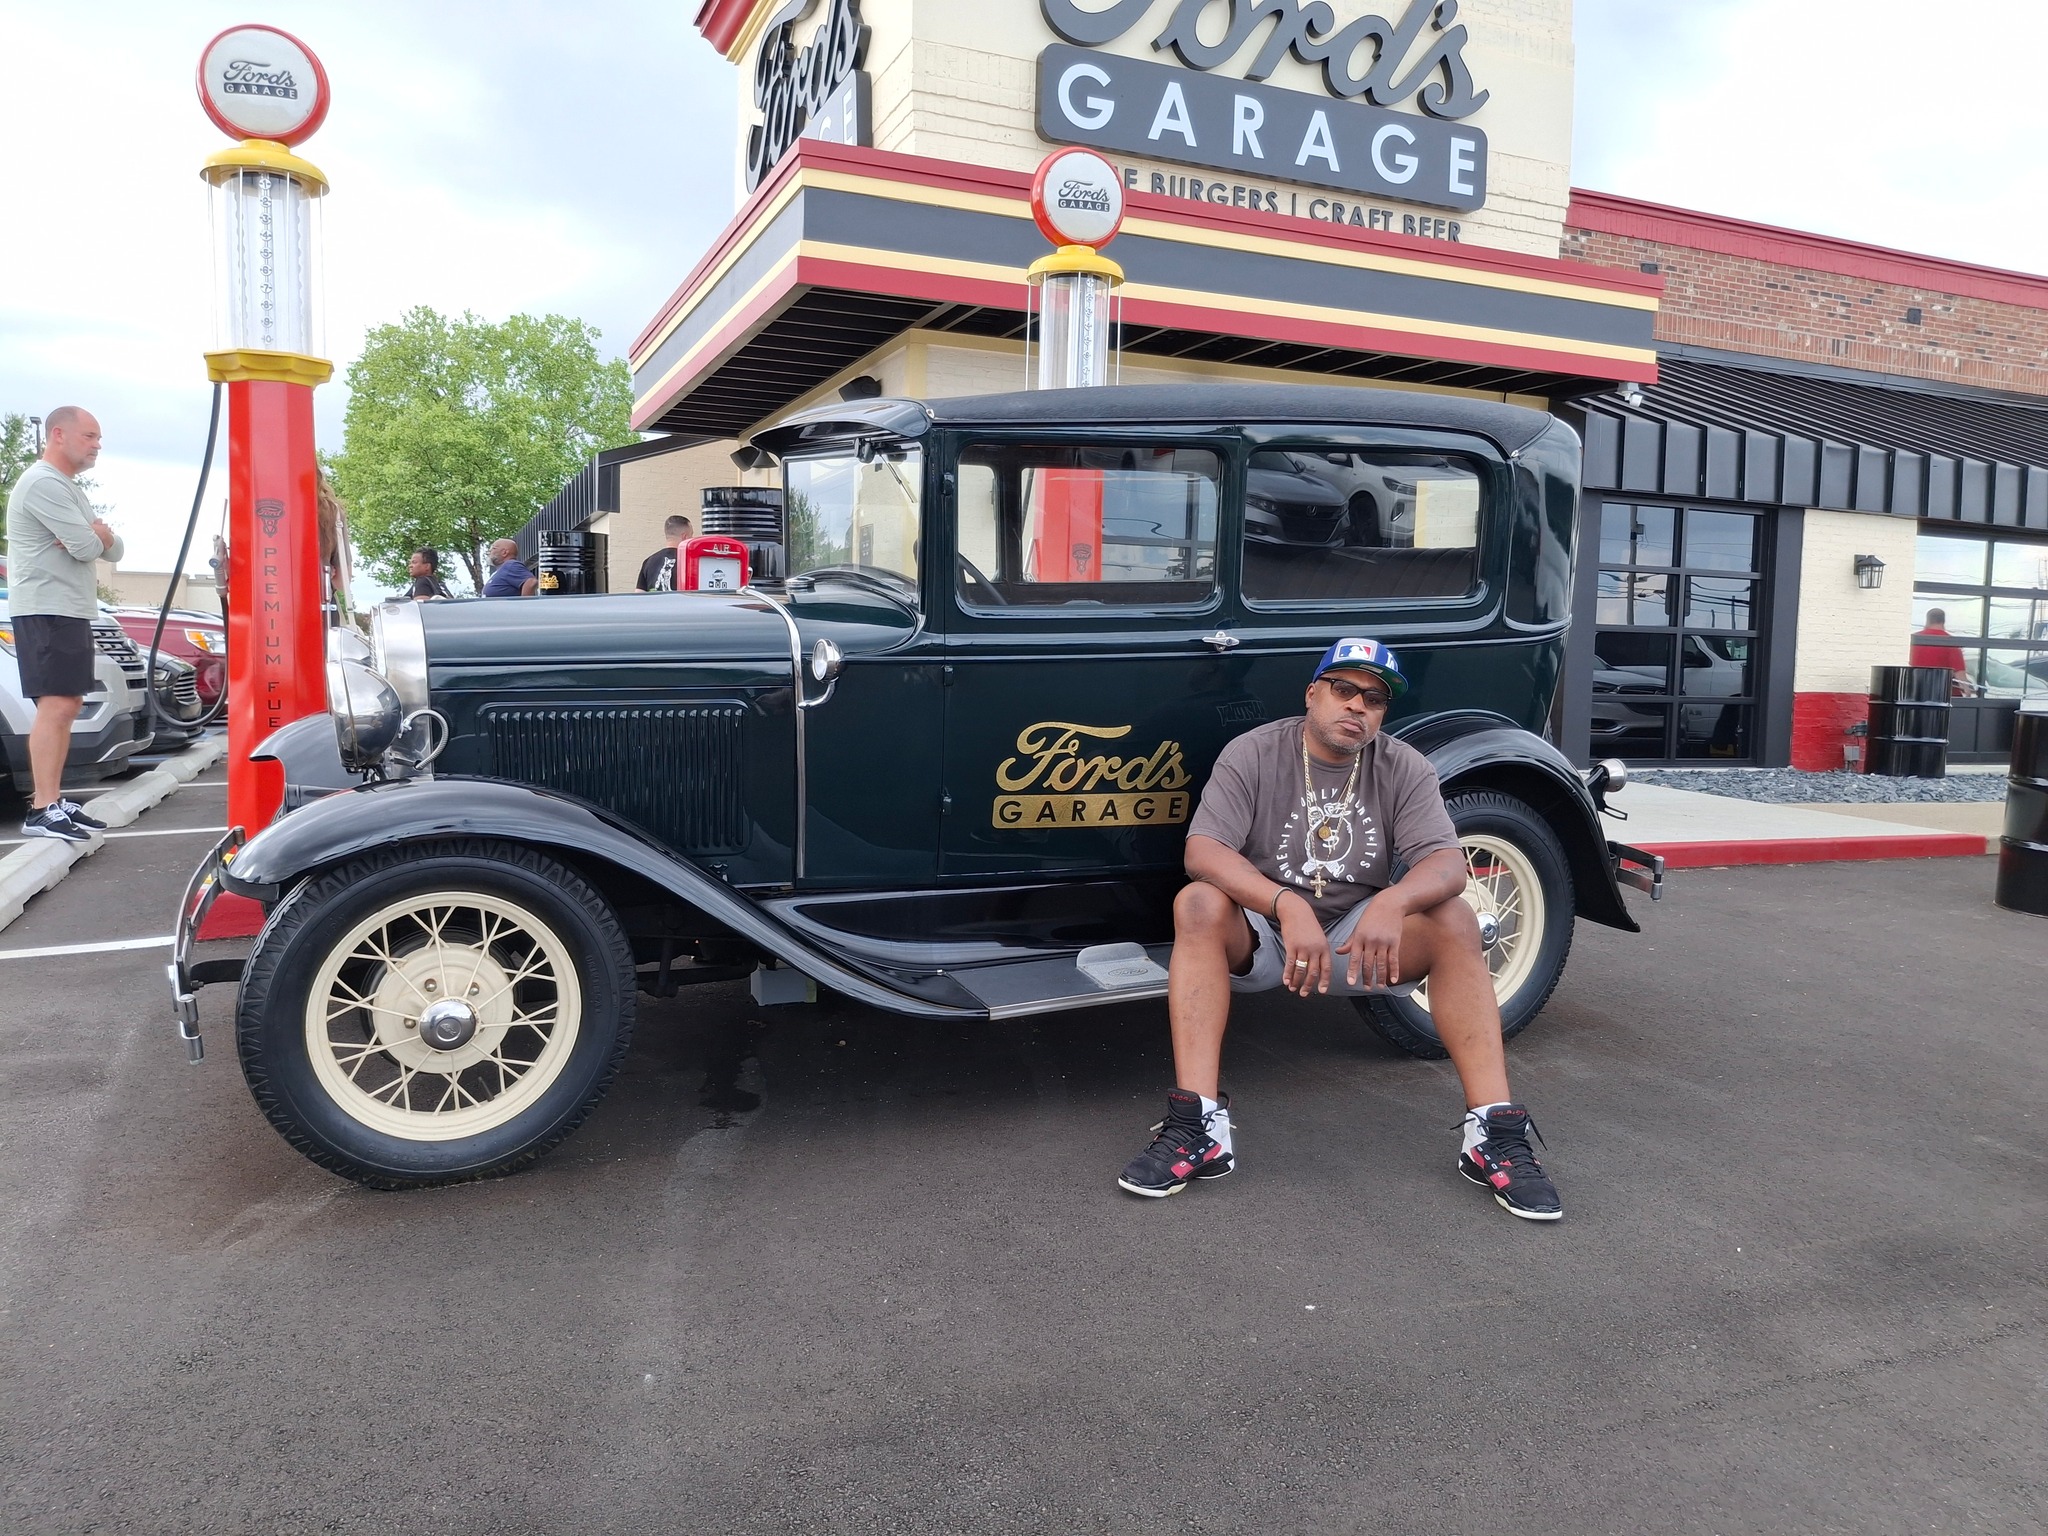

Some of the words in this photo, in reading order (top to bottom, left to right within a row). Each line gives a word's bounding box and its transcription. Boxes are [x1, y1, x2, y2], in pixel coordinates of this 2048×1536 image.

[223, 60, 297, 87] Ford's
[1040, 0, 1490, 120] ord's
[226, 83, 296, 99] GARAGE
[746, 0, 863, 194] Fords
[1057, 62, 1477, 197] GARAGE
[1058, 180, 1110, 202] Ford's
[1060, 199, 1109, 212] GARAGE
[1152, 172, 1280, 214] BURGERS
[1309, 199, 1395, 233] CRAFT
[1403, 213, 1463, 244] BEER
[713, 543, 730, 552] AIR
[264, 547, 281, 665] PREMIUM
[267, 681, 282, 728] FUE
[996, 721, 1192, 792] Ford's
[999, 797, 1183, 824] GARAGE
